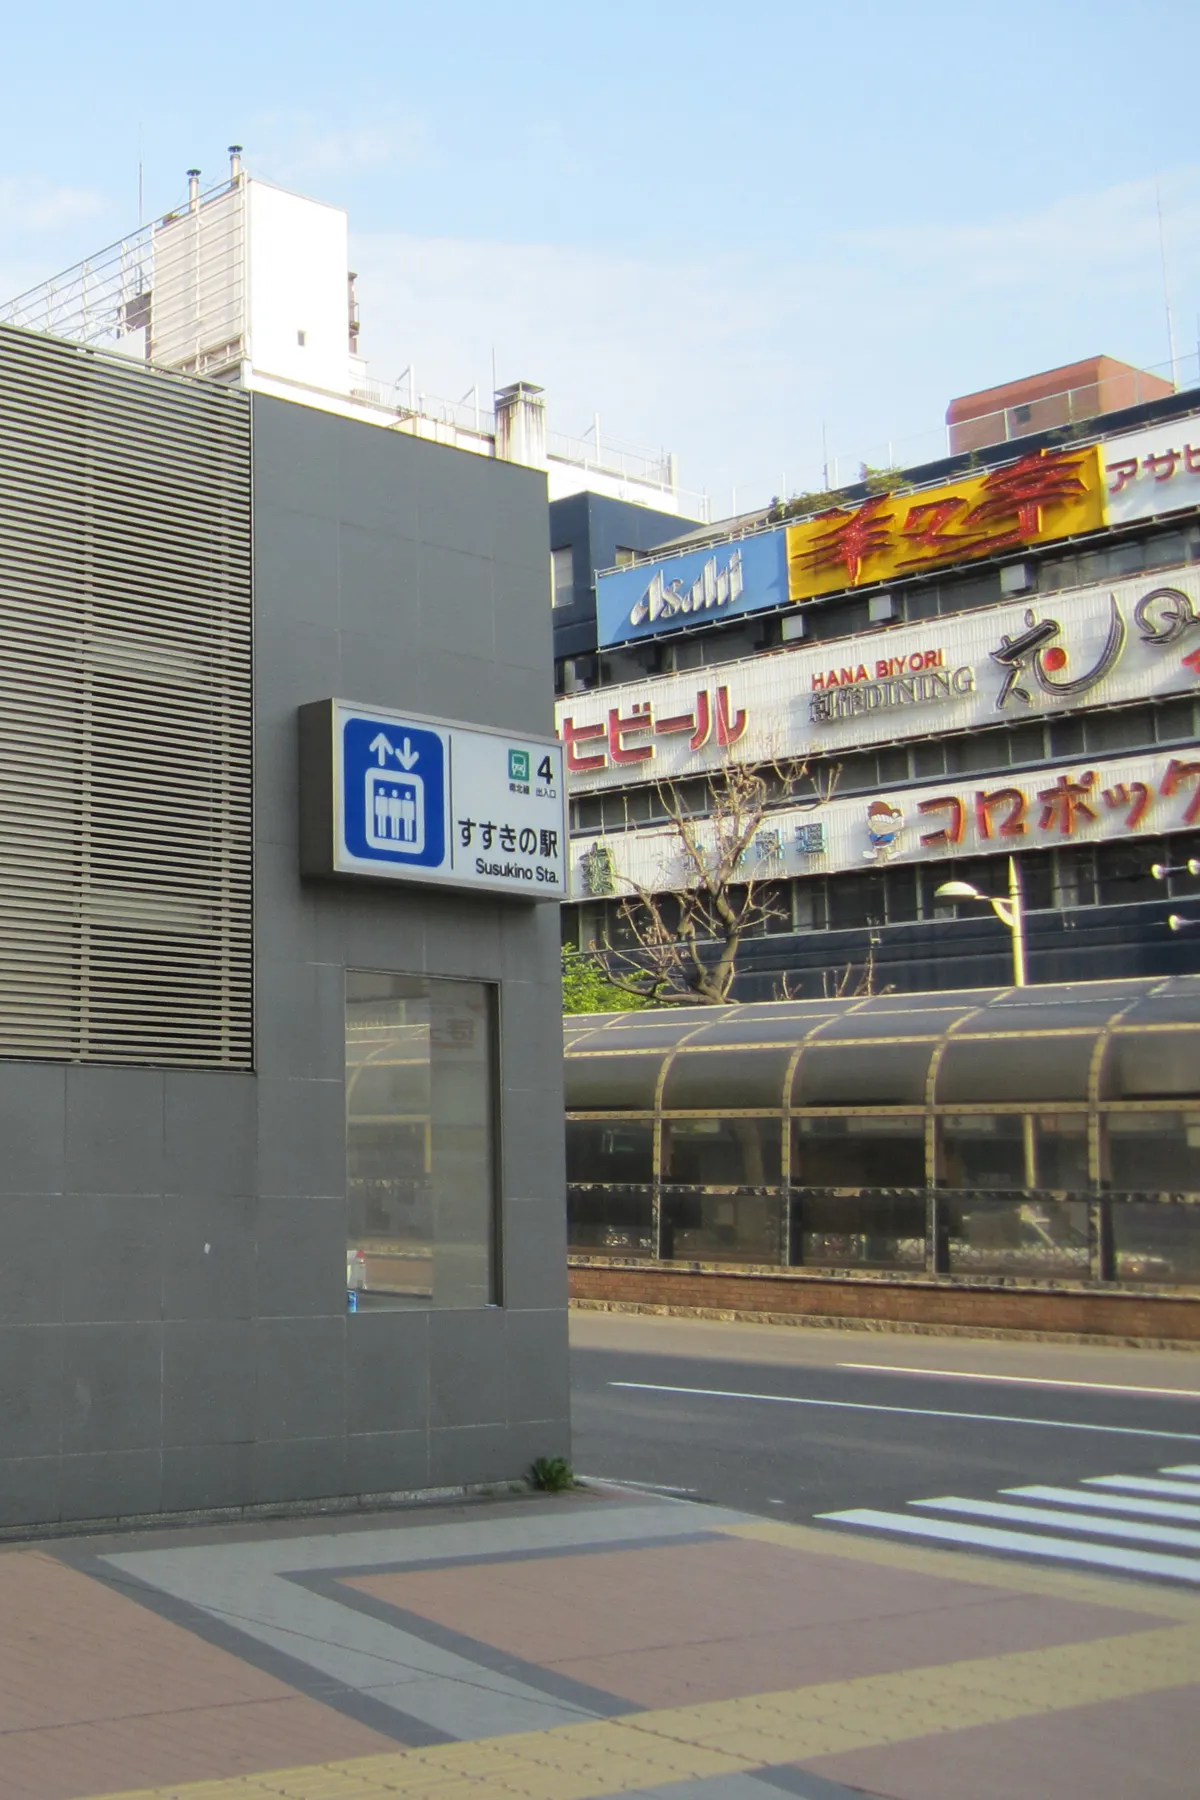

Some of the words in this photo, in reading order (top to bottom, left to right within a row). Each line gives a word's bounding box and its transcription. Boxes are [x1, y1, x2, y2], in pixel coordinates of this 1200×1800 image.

[630, 548, 743, 626] Asahi
[811, 664, 871, 691] HANA
[875, 648, 946, 679] BIYORI
[555, 685, 749, 772] ヒビール
[537, 755, 553, 785] 4
[536, 786, 556, 799] 出入口
[458, 817, 558, 858] すすきの駅
[476, 857, 533, 880] Susukino
[535, 865, 559, 884] Sta.
